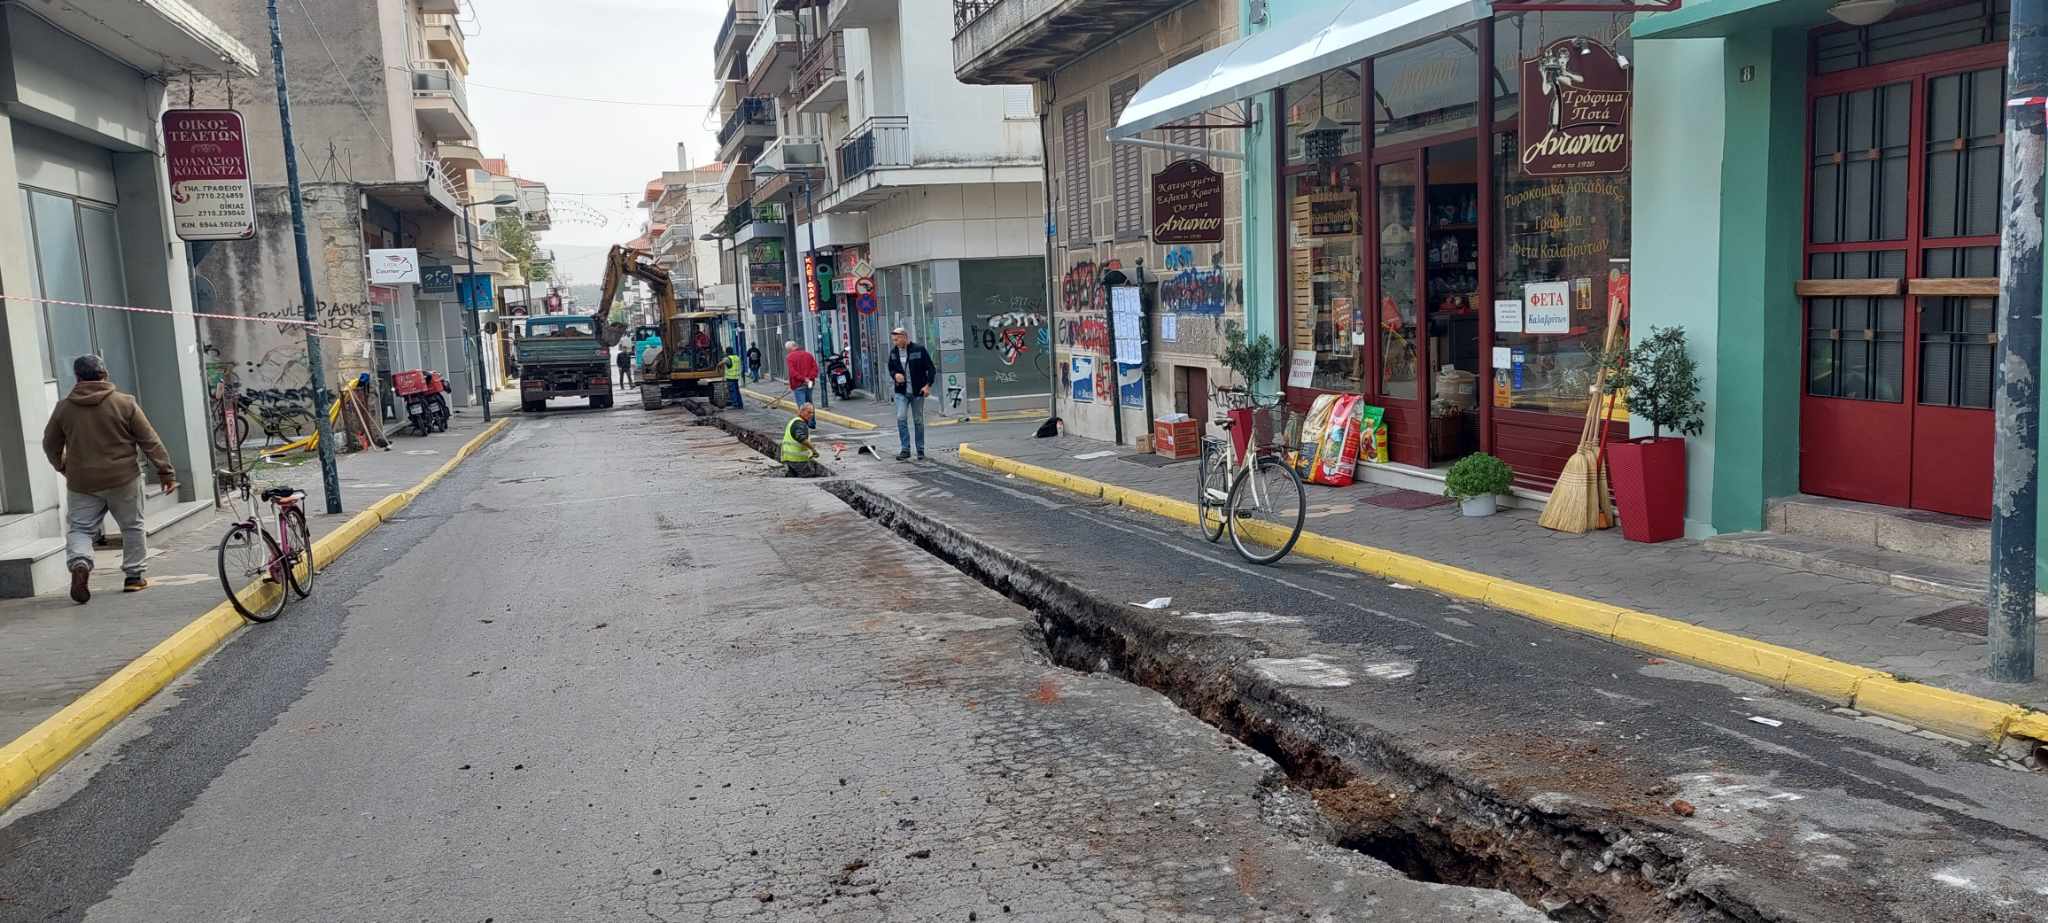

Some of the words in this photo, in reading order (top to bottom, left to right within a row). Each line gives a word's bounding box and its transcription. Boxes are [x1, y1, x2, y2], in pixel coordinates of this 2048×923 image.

[1743, 67, 1751, 81] 8
[1562, 90, 1623, 107] Τρόφιμα
[1571, 107, 1610, 120] Ποτά
[179, 120, 228, 130] ΟΙΚΟΣ
[169, 131, 240, 141] ΤΕΛΕΤΩΝ
[1523, 126, 1624, 164] Αντωνίου
[174, 157, 241, 167] ΑΘΑΝΑΣΙΟΥ
[1155, 213, 1221, 236] Αντωνίου
[1530, 292, 1564, 307] ΦΕΤΑ
